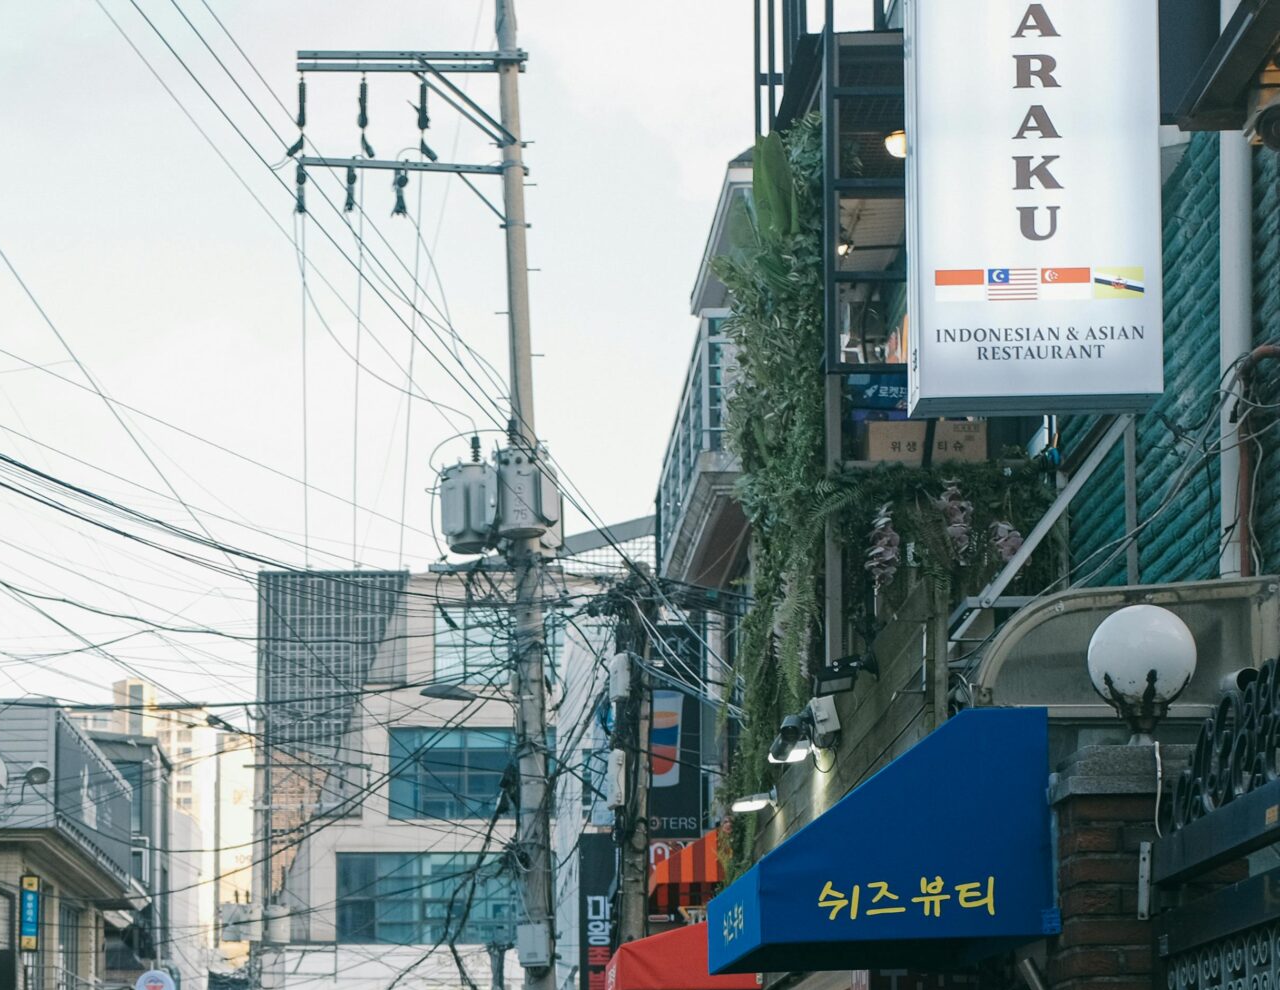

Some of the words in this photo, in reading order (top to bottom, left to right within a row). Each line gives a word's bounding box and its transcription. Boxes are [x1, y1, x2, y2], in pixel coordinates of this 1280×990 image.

[1011, 3, 1064, 241] ARAKU
[935, 327, 1060, 343] INDONESIAN
[1066, 328, 1079, 341] &
[1085, 325, 1145, 341] ASIAN
[977, 345, 1105, 361] RESTAURANT
[891, 442, 918, 453] 위생
[818, 876, 995, 920] 쉬즈뷰티
